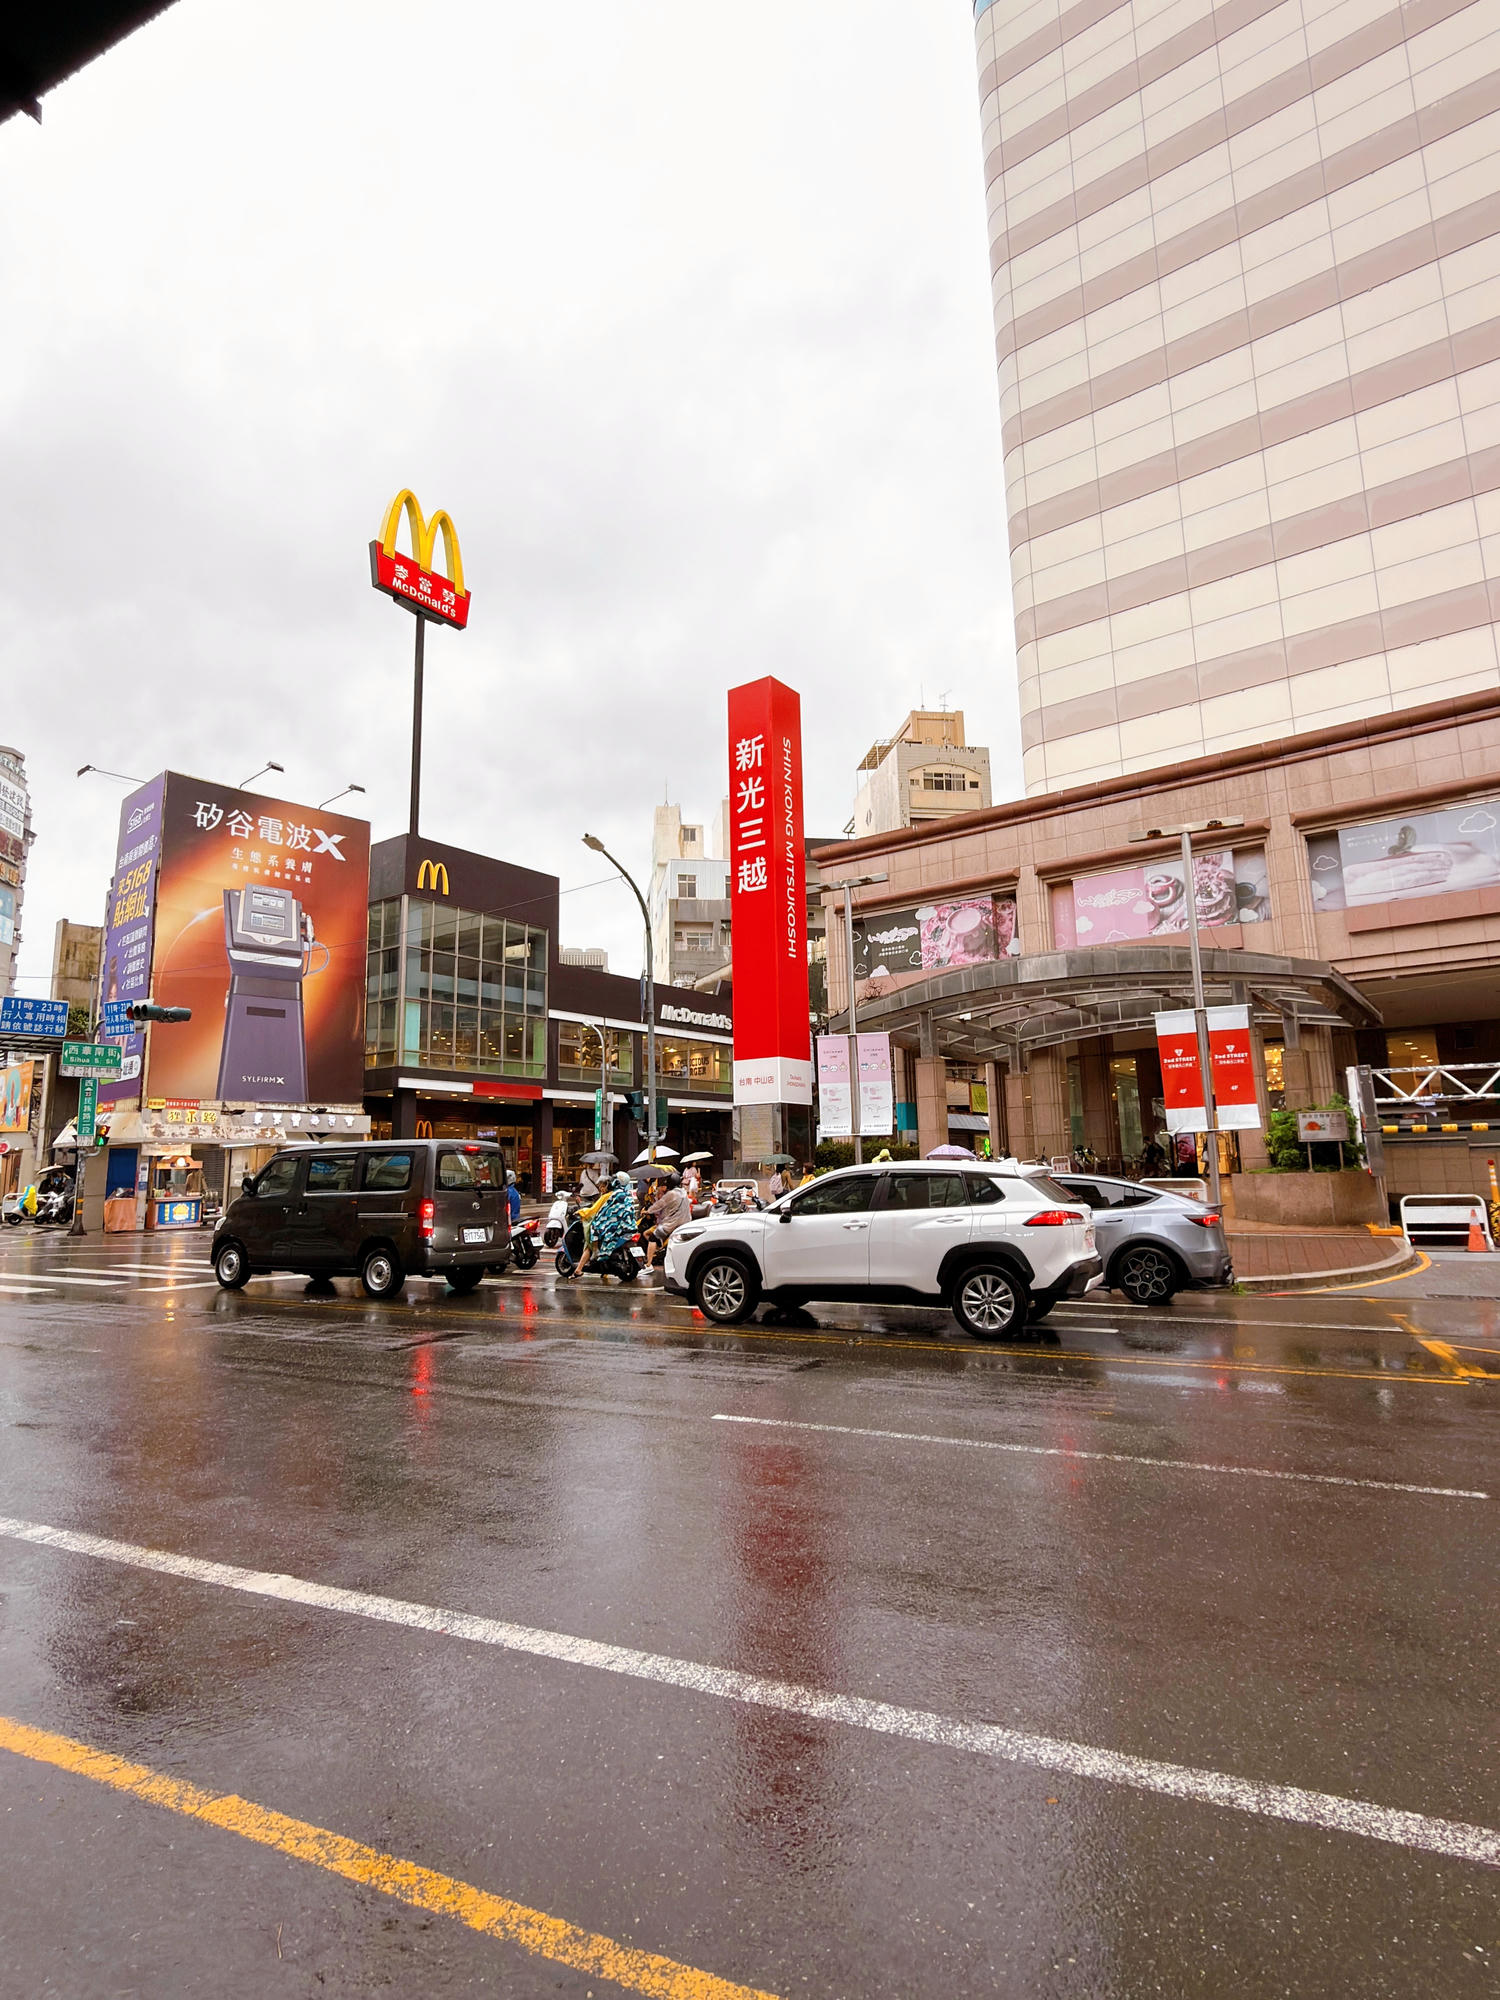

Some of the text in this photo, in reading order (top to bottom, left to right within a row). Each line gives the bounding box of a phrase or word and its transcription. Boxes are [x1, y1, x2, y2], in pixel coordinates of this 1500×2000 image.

[392, 577, 456, 618] McDonald's
[187, 801, 348, 862] 矽谷電波X
[735, 734, 768, 894] 新光三越
[782, 737, 797, 958] SHIN KONG MITSUKOSHI
[2, 1010, 66, 1024] 行人專用時相
[660, 1004, 733, 1030] McDonald's
[754, 1075, 775, 1085] 中山店
